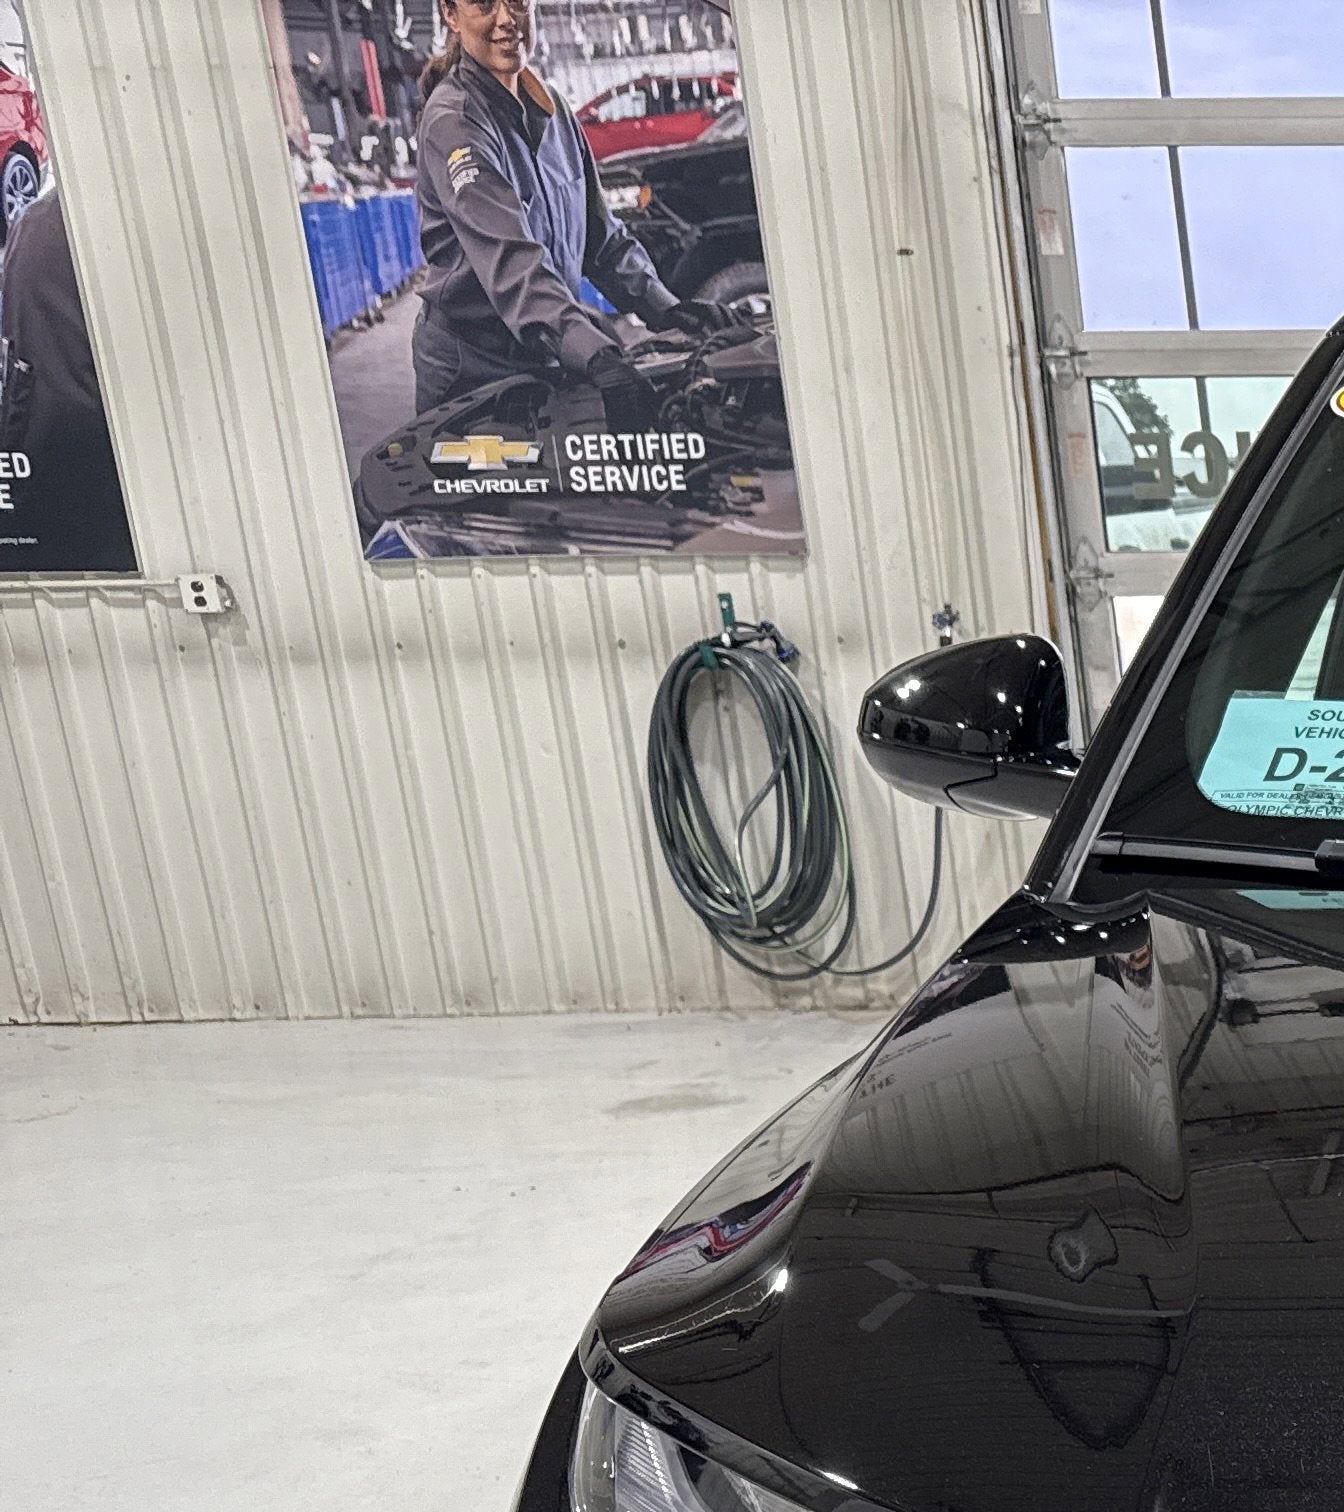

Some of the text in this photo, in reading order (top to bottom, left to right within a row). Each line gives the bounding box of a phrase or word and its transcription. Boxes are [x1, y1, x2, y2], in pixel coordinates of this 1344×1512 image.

[565, 432, 706, 461] CERTIFIED
[433, 478, 550, 494] CHEVROLET
[569, 464, 687, 492] SERVICE
